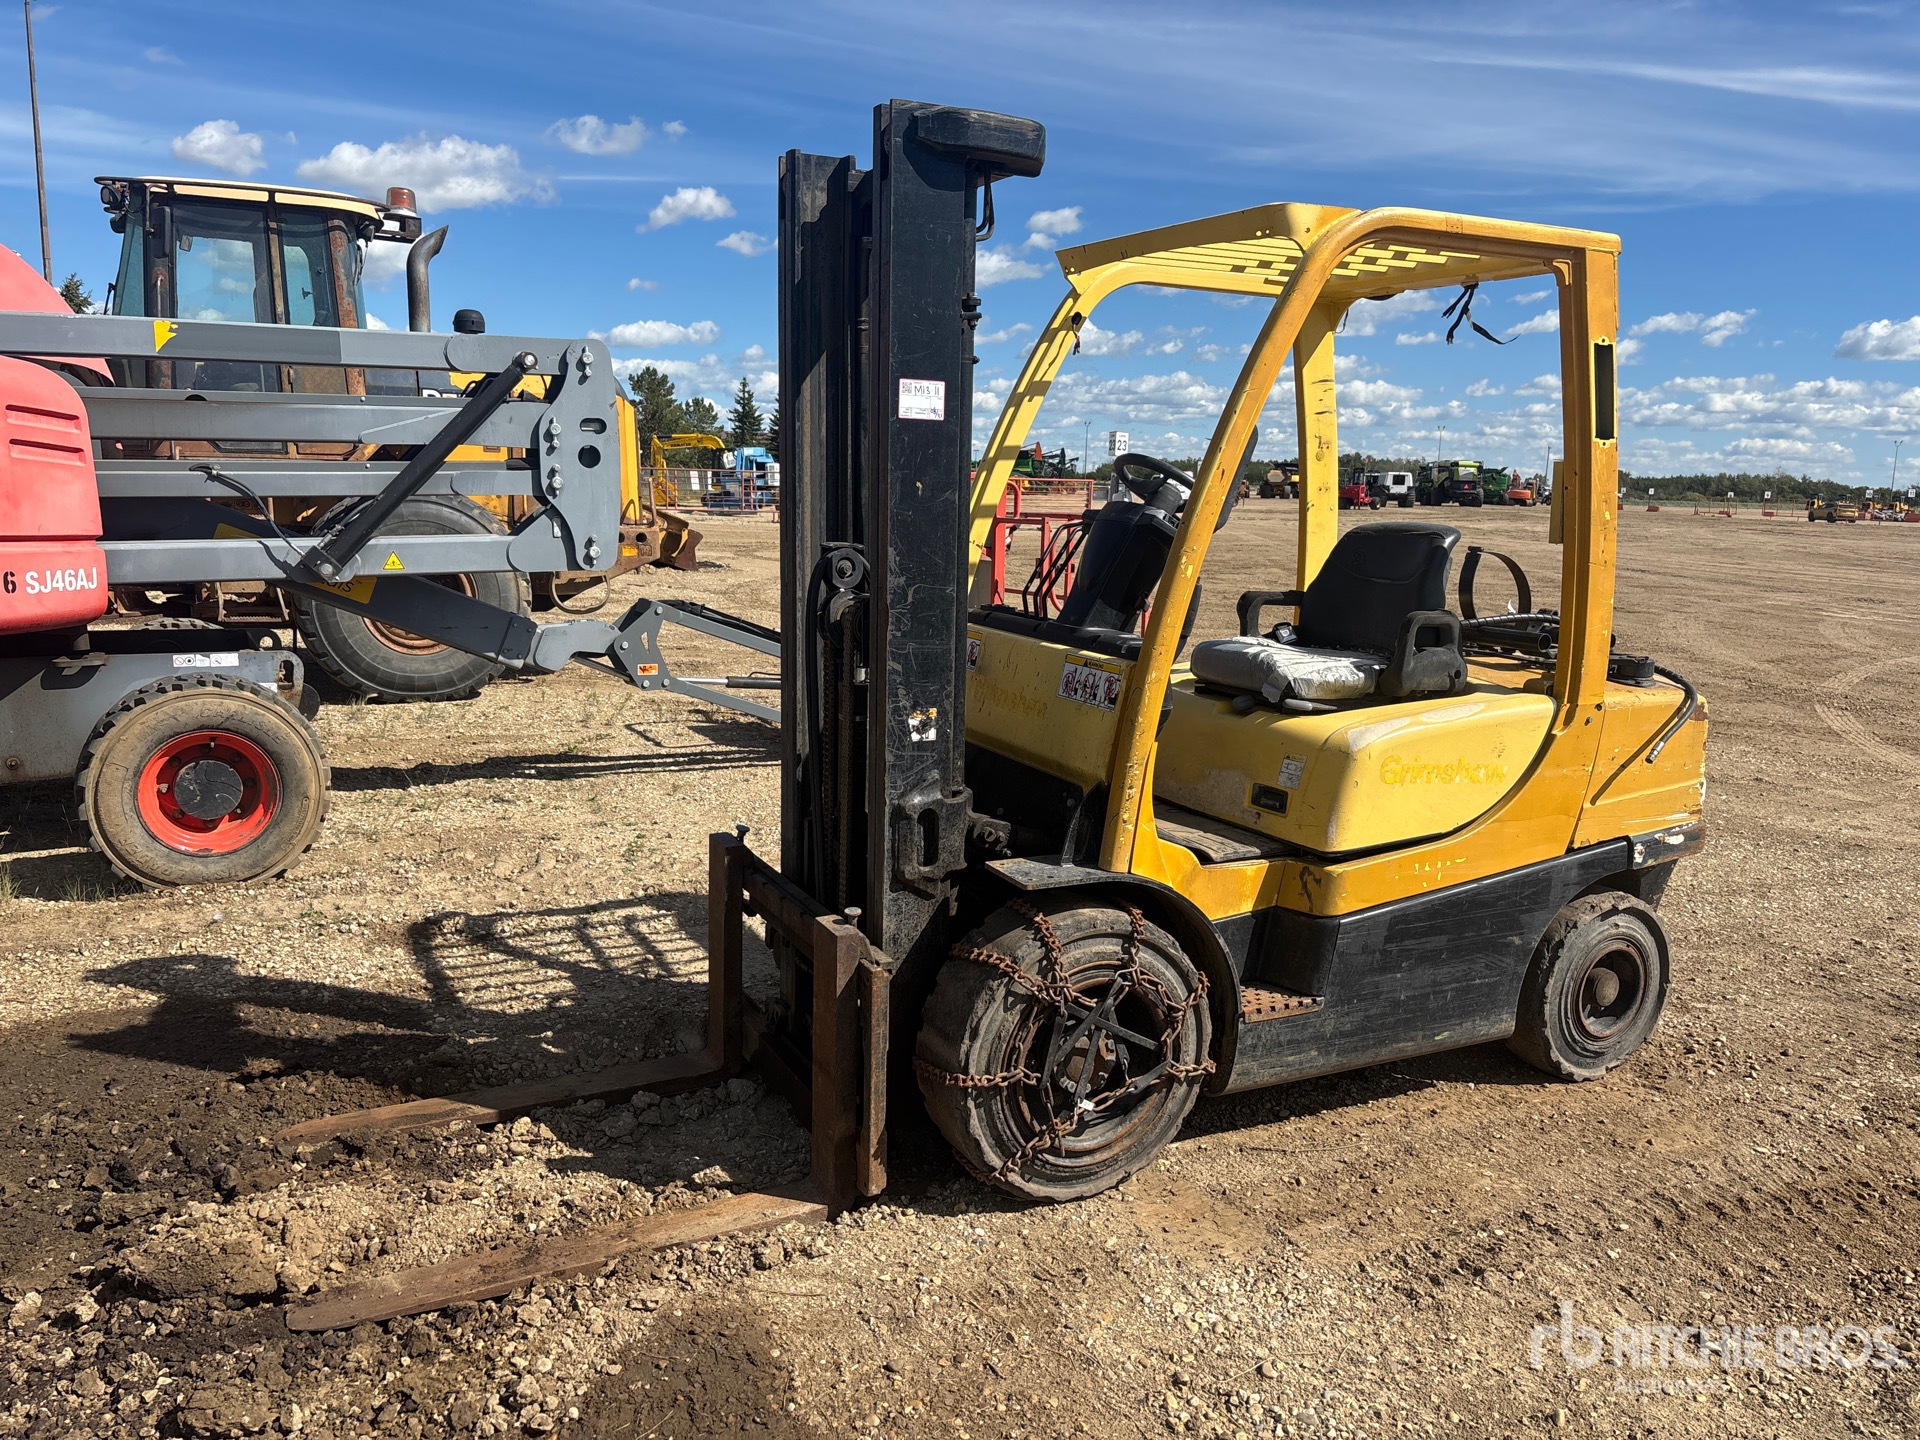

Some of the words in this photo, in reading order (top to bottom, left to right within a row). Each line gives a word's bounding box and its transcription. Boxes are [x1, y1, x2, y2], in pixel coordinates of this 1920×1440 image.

[1117, 439, 1127, 452] 23
[3, 571, 17, 594] 6
[25, 566, 98, 595] SJ46AJ
[1380, 754, 1508, 785] Grimshaw
